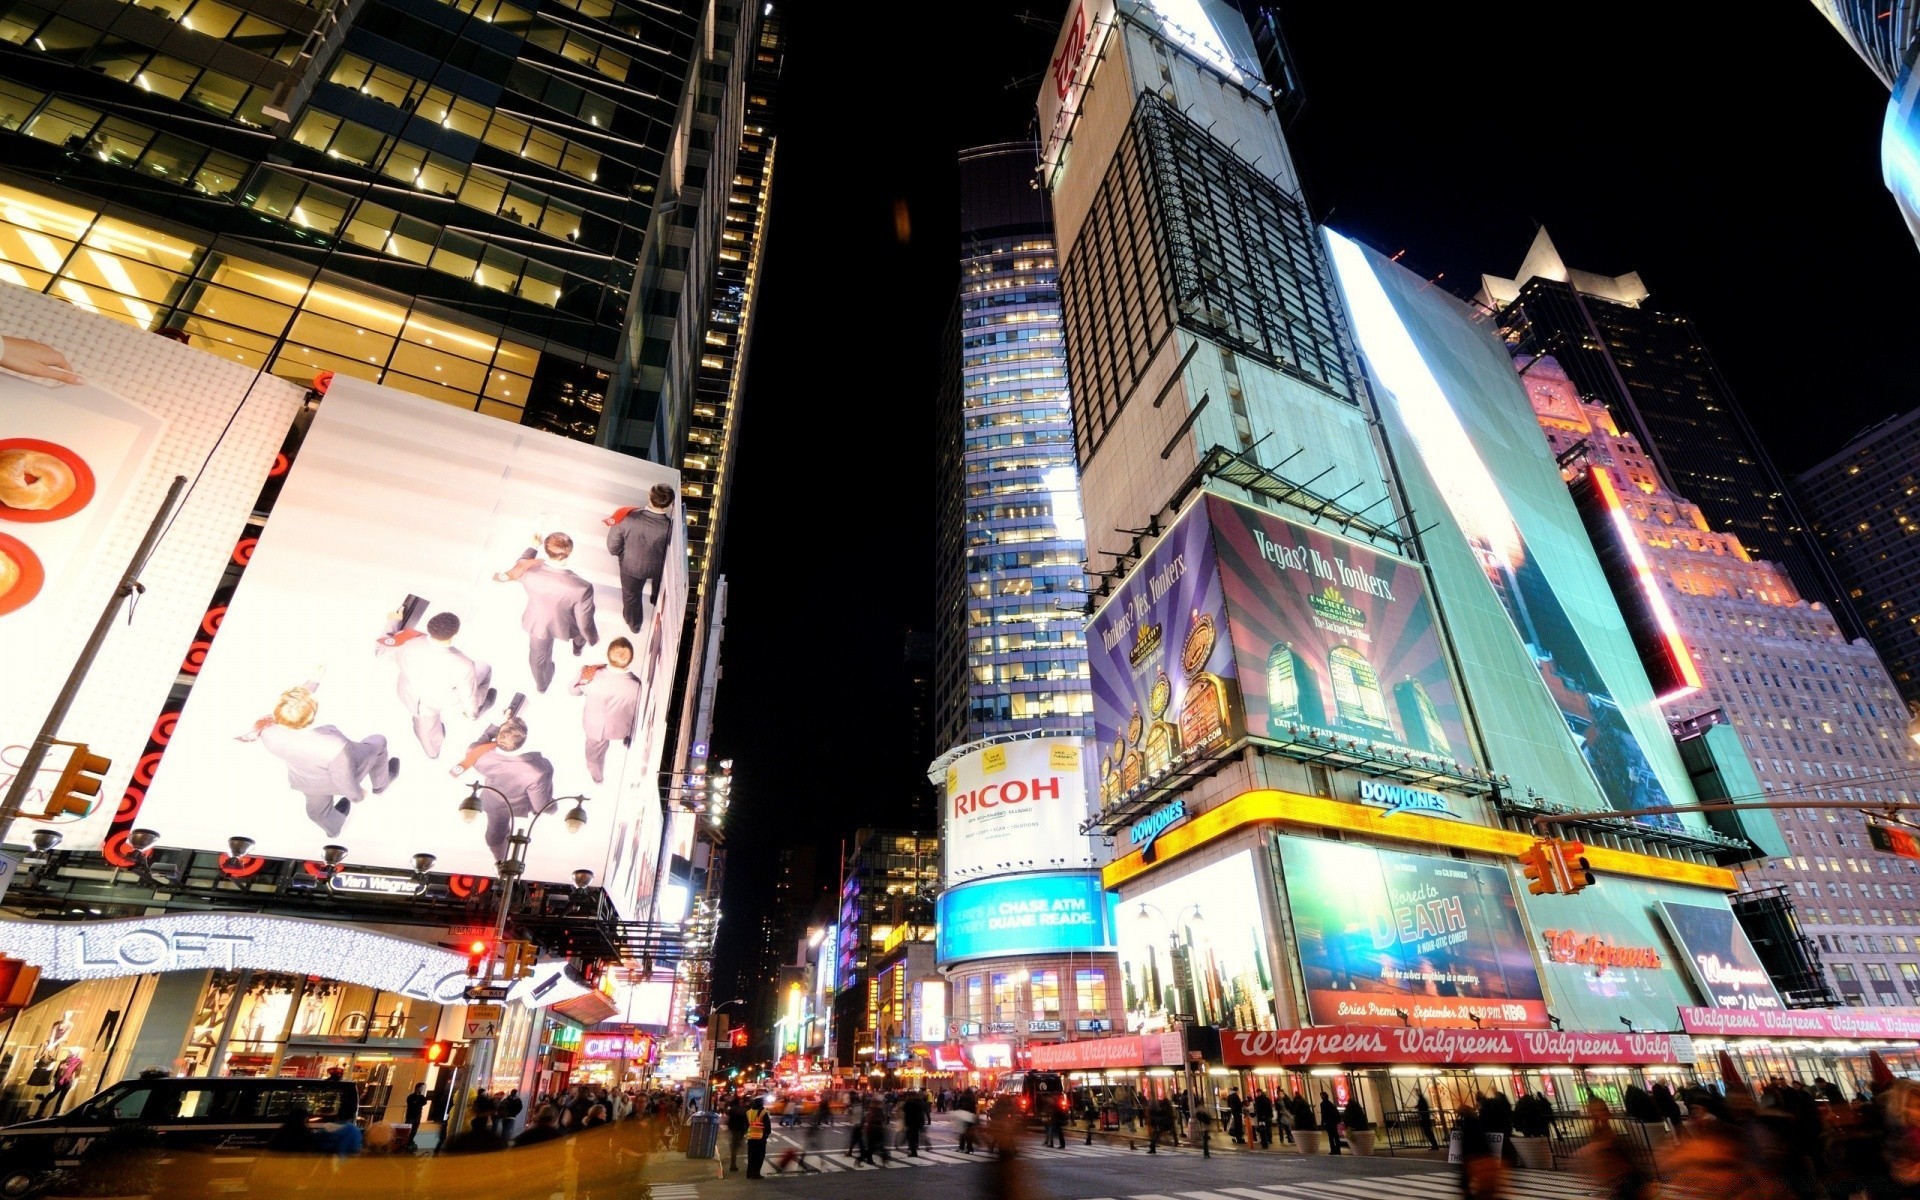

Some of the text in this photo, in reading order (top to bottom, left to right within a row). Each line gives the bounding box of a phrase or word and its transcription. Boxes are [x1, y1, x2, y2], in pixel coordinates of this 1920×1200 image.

[1253, 529, 1396, 601] Vegas? No, Yonkers.
[1102, 603, 1134, 654] Yonkers?
[1134, 593, 1151, 620] Yes,
[1149, 554, 1187, 604] Yonkers.
[1324, 606, 1352, 618] CASINO
[1342, 605, 1361, 615] CITY
[1312, 616, 1325, 628] The
[1274, 717, 1291, 728] EXIT
[1300, 724, 1311, 734] NY
[954, 777, 1060, 819] RICOH
[340, 876, 421, 895] Van Wagner
[1391, 883, 1439, 906] Bored to
[998, 899, 1048, 915] CHASE
[1052, 898, 1086, 911] ATM
[450, 927, 485, 935] BROADWAY
[989, 916, 1038, 930] DUANE
[1039, 913, 1096, 927] READE.
[1368, 895, 1467, 950] DEATH
[75, 930, 253, 972] LOFT
[1417, 930, 1468, 955] A NOIR-OTIC COMEDY
[1542, 928, 1664, 977] Walgreens
[1381, 967, 1394, 979] How
[1394, 970, 1402, 979] he
[1403, 971, 1421, 980] solves
[1421, 970, 1446, 984] anything
[1446, 972, 1453, 982] is
[1457, 973, 1480, 986] mystery.
[1697, 954, 1768, 991] Walgreens
[1338, 1002, 1367, 1016] Series
[1413, 1004, 1457, 1019] September
[1486, 1007, 1502, 1019] PM
[1501, 1004, 1527, 1021] HBO
[1717, 992, 1779, 1010] open 24 hours
[1685, 1008, 1759, 1035] Walgreens
[1760, 1010, 1824, 1037] Walgreens
[1827, 1013, 1882, 1038] Walgreens
[1033, 1041, 1138, 1065] Walgreens Walgreens
[1233, 1032, 1387, 1063] Walgreens
[1394, 1029, 1513, 1063] Walgreens
[1523, 1031, 1624, 1062] Walgreens
